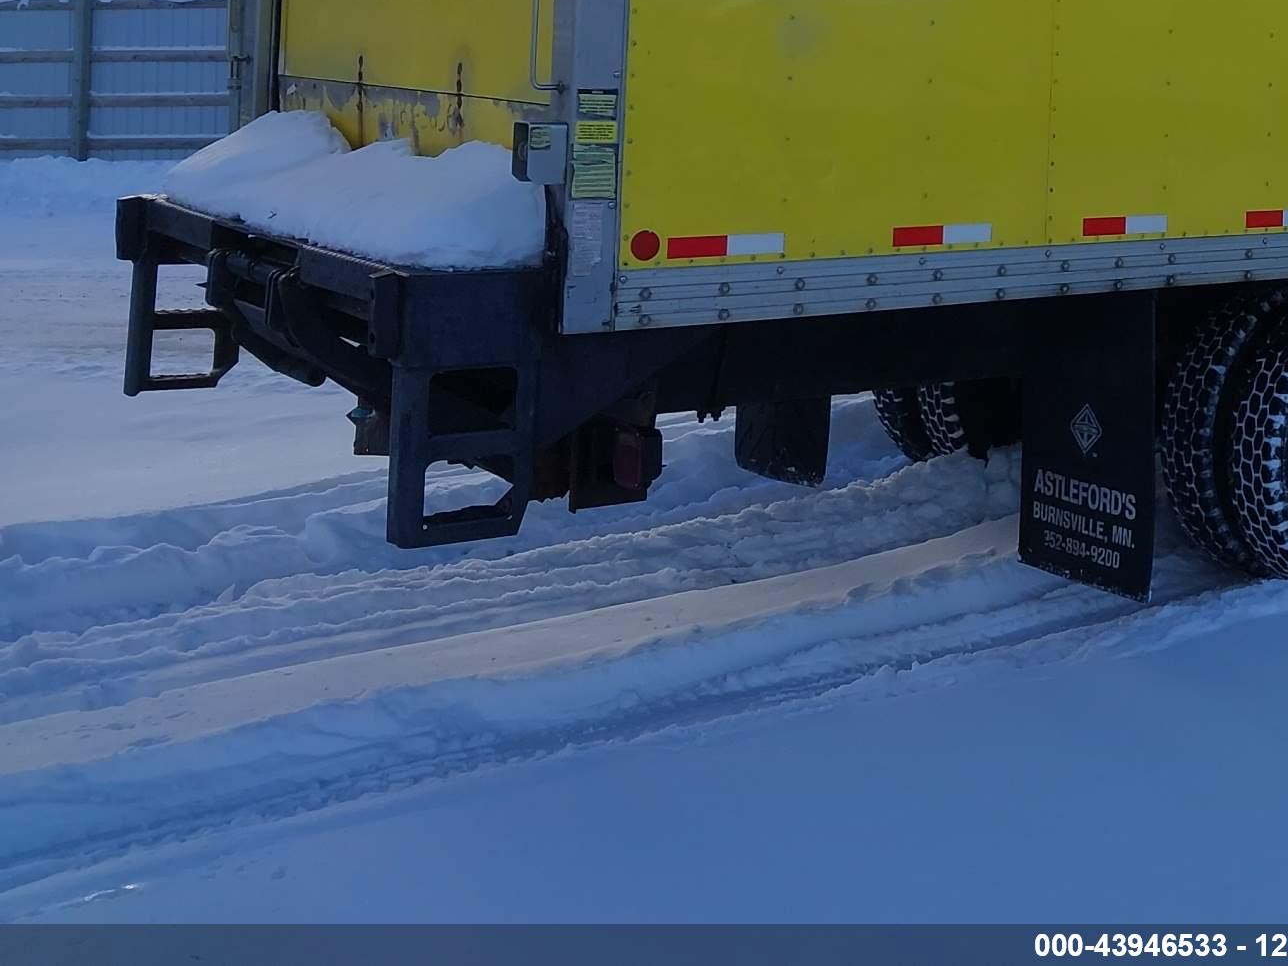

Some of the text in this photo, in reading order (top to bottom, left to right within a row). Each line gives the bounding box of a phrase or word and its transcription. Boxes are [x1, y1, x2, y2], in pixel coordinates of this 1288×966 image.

[1034, 468, 1136, 520] ASTLEFORD'S
[1033, 501, 1136, 549] BURNSVILLE, MN.
